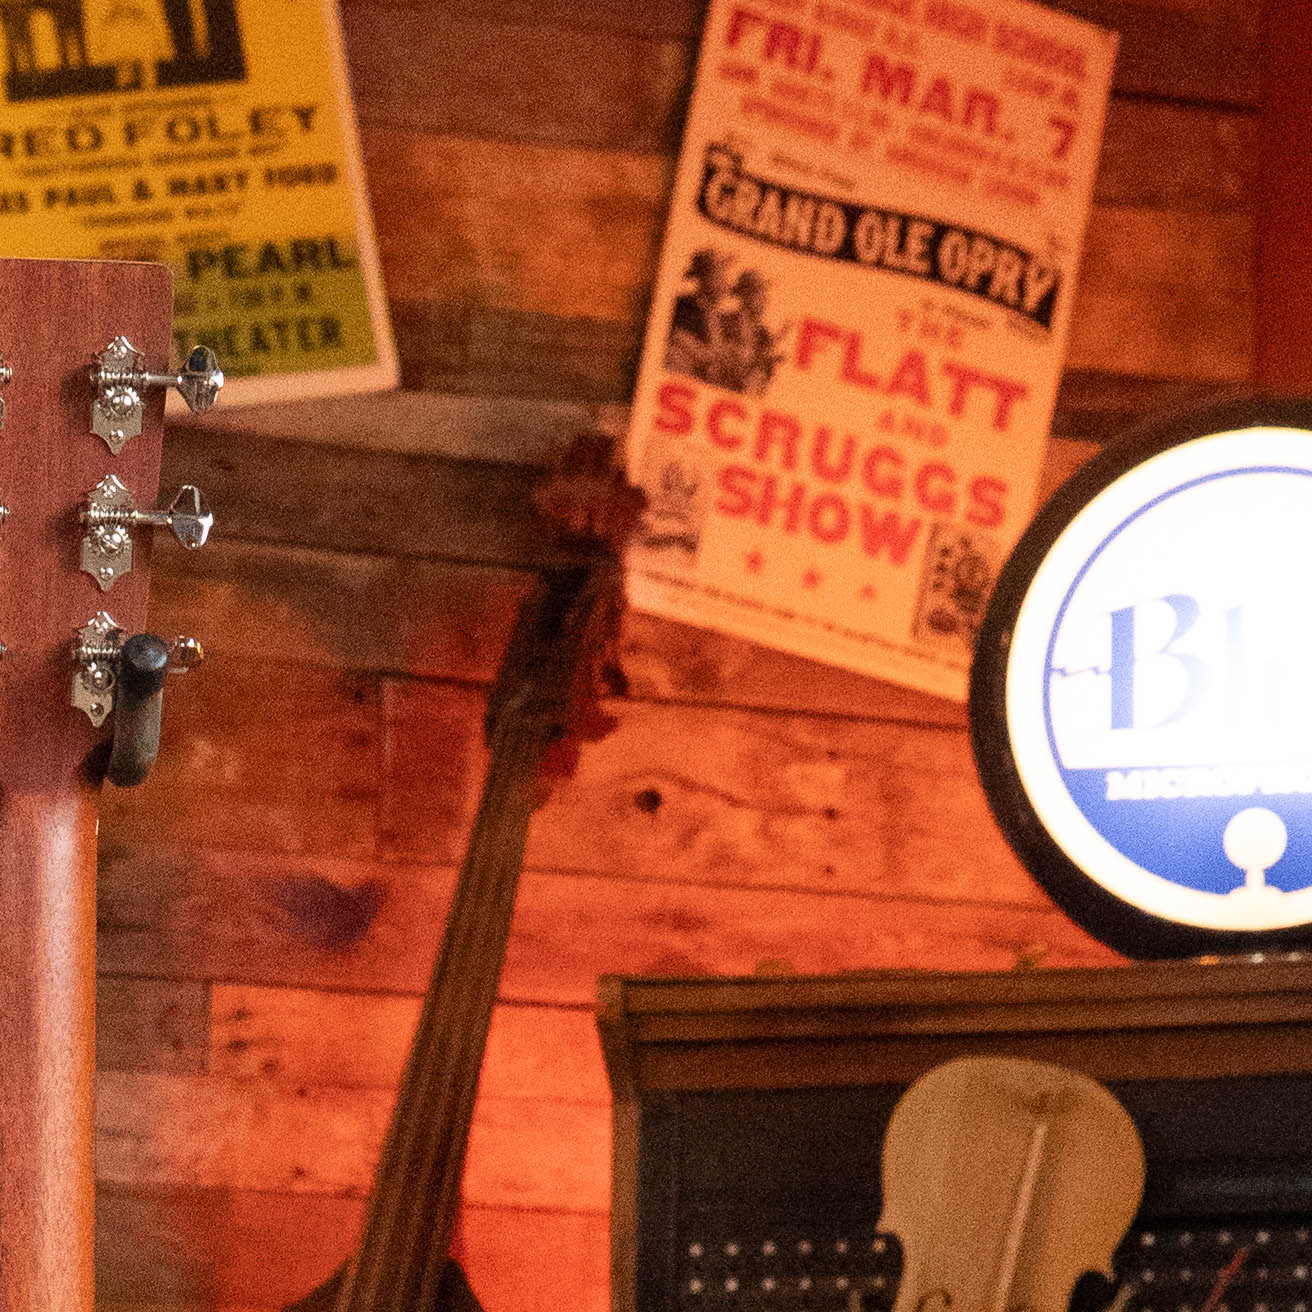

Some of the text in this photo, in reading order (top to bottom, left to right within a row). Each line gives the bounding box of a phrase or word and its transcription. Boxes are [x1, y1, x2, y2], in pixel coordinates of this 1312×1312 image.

[125, 106, 318, 147] FOLEY
[861, 53, 1018, 144] MAR.
[1047, 114, 1079, 160] 7
[189, 237, 357, 281] PEARL
[703, 168, 850, 257] GRAND
[854, 209, 936, 278] OLE
[938, 232, 1060, 315] OPRY
[794, 317, 1031, 432] FLATT
[654, 379, 1009, 531] SCRUGGS
[715, 464, 923, 568] SHOW
